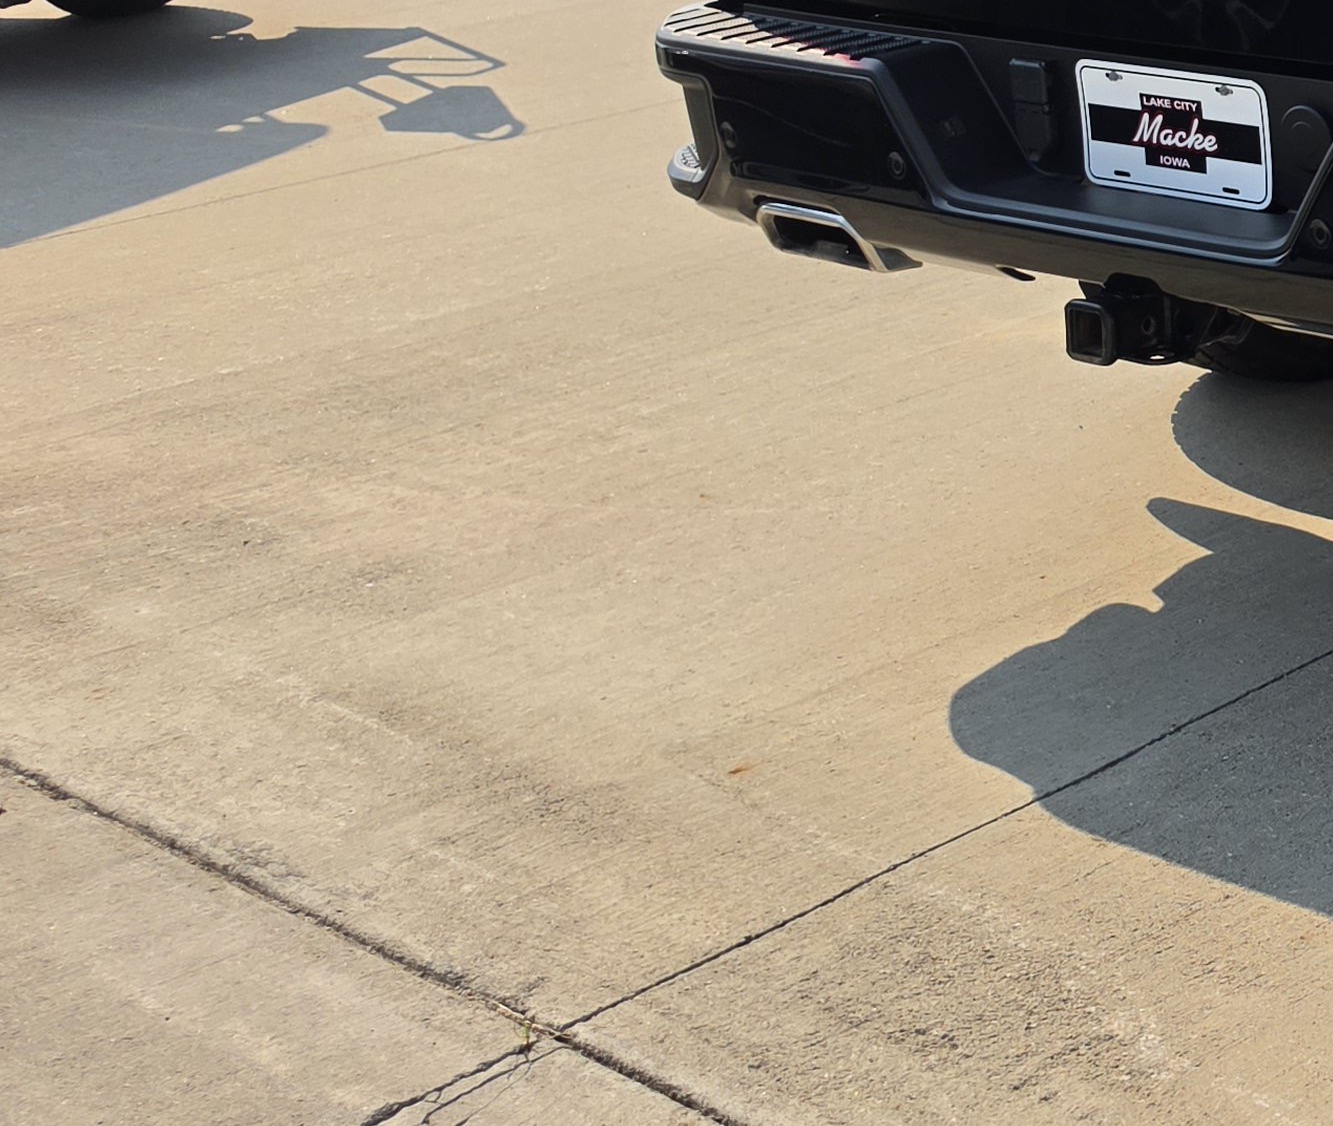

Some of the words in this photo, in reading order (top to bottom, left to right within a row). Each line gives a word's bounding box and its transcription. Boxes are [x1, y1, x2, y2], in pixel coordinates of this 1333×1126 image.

[1142, 96, 1172, 109] LAKE
[1174, 100, 1198, 112] CITY
[1132, 112, 1218, 152] Macke
[1160, 155, 1190, 168] IOWA
